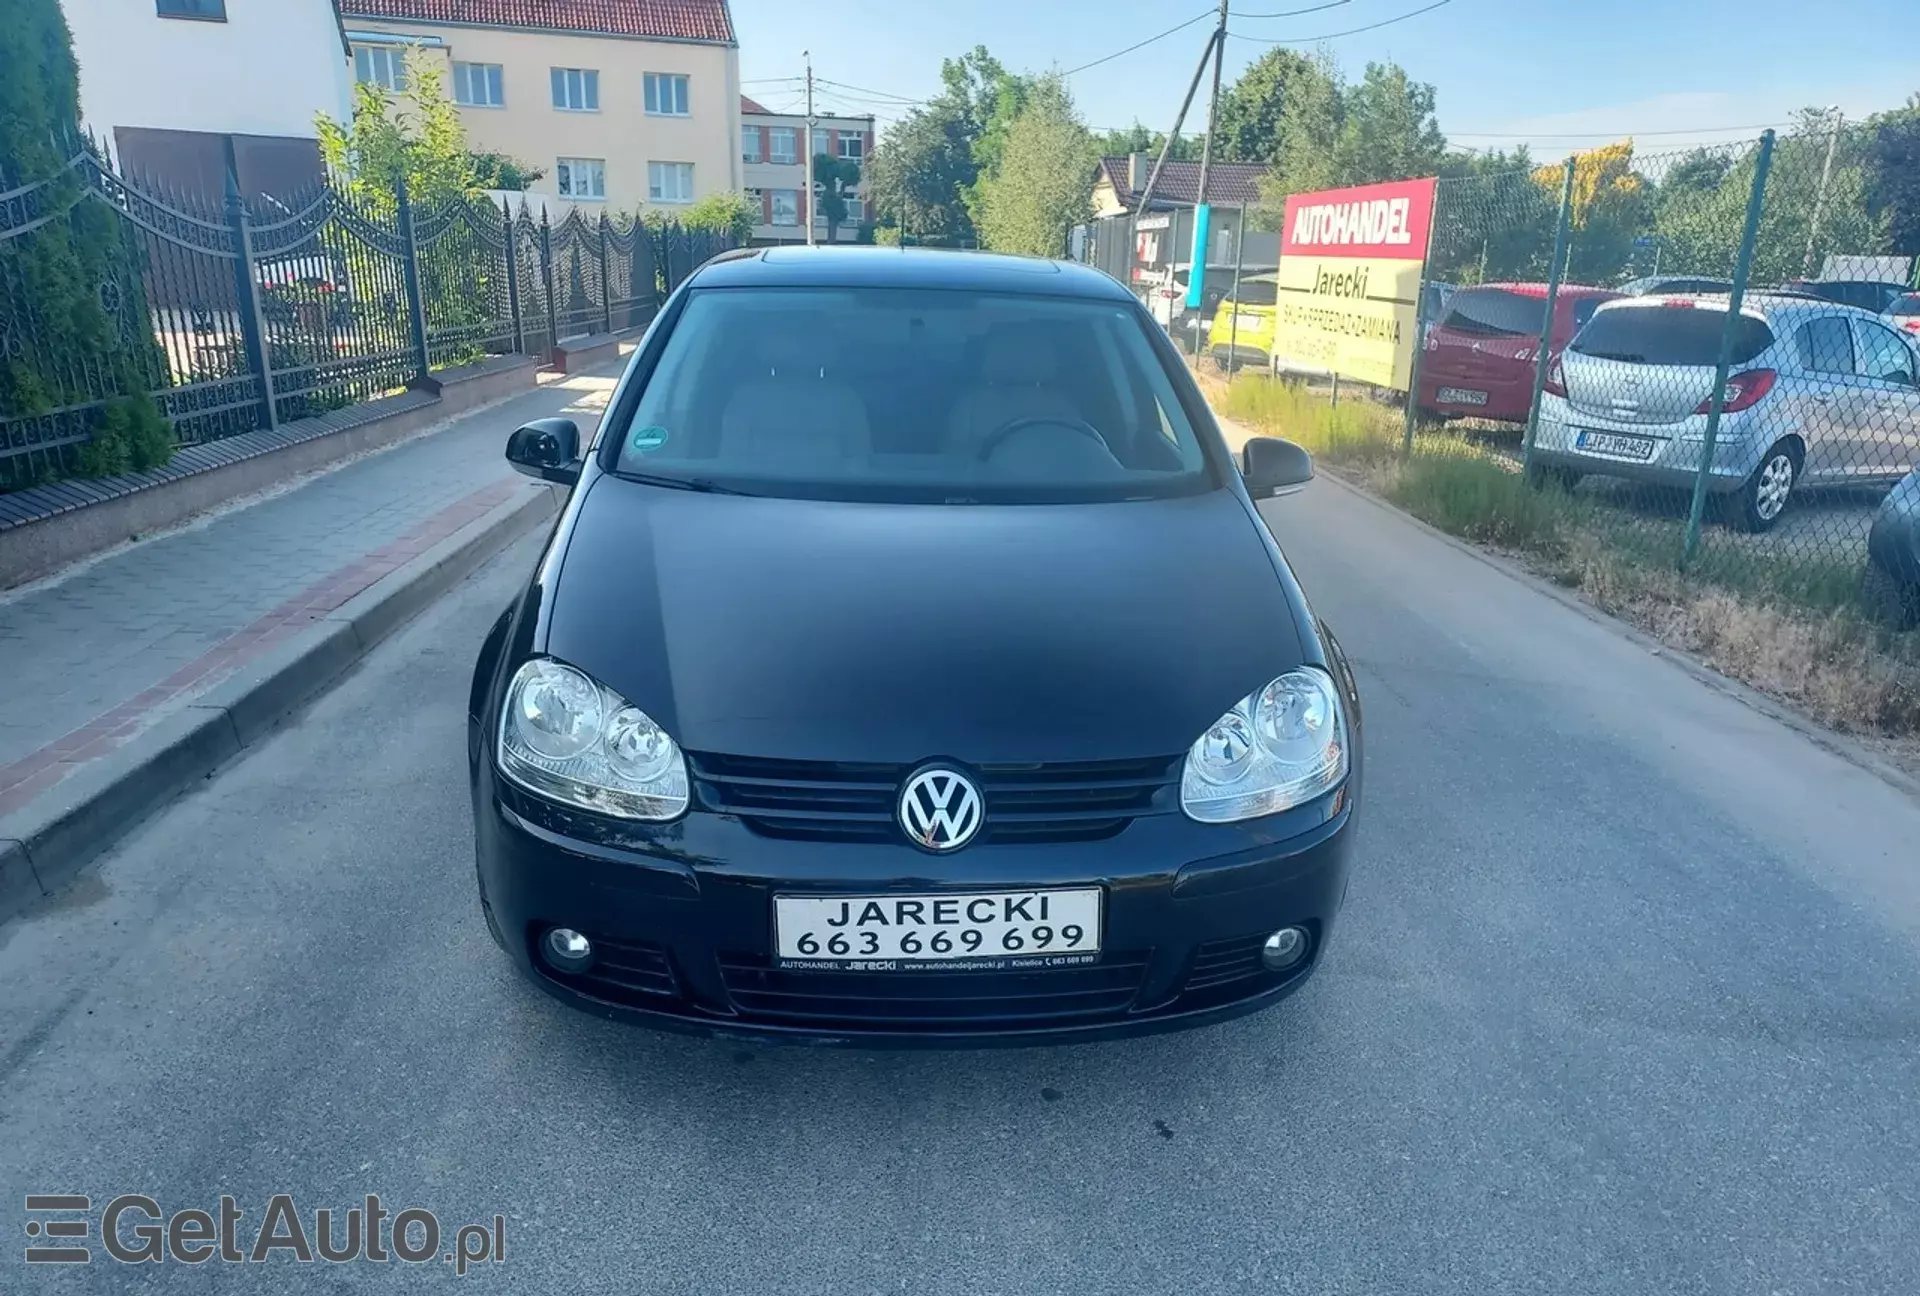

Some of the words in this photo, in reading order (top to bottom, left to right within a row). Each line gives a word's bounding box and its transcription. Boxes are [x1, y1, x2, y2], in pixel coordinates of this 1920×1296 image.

[1291, 197, 1411, 246] AUTOHANDEL
[1312, 264, 1369, 300] Jarecki
[826, 896, 1049, 927] JARECKI
[797, 931, 880, 955] 663
[900, 929, 983, 954] 669
[1002, 924, 1084, 951] 699
[780, 961, 840, 970] AUTOHANDEL
[844, 960, 896, 971] Jarecki
[904, 960, 1005, 971] www.autohandeljarecki.pl
